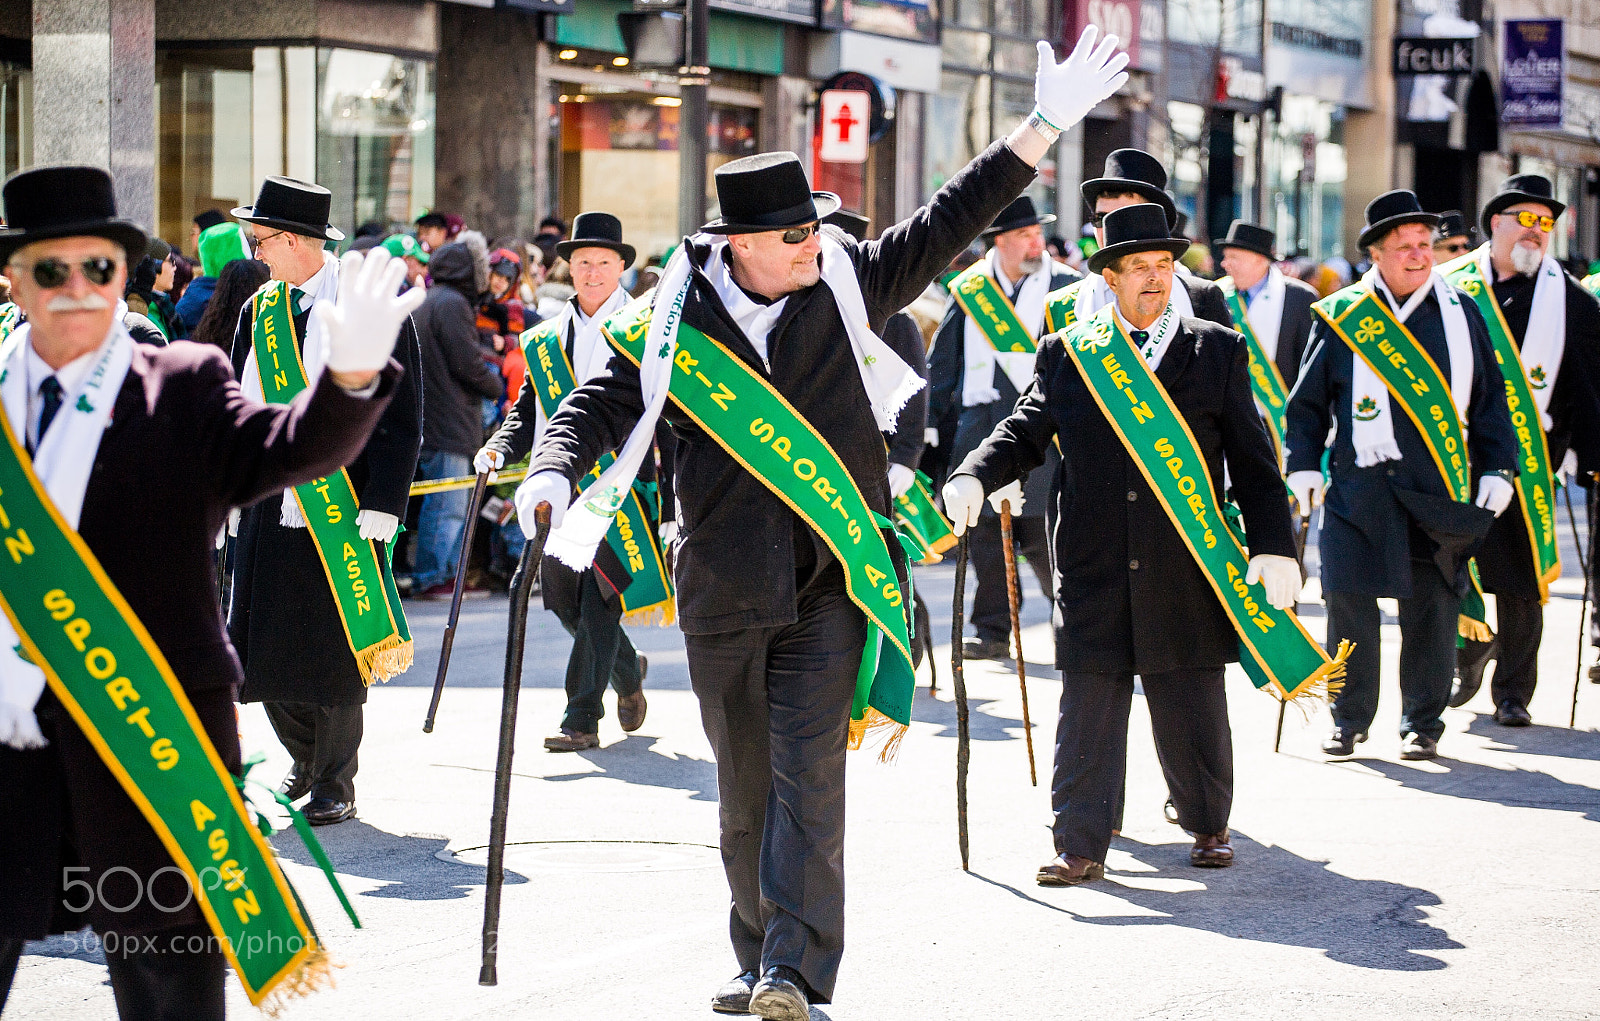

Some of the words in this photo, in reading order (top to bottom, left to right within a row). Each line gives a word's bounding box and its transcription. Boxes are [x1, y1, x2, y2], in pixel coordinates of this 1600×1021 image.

[1398, 40, 1471, 71] fcuk
[974, 291, 1011, 336] ERIN
[1152, 318, 1170, 345] Erin
[263, 314, 288, 391] ERIN
[536, 341, 562, 400] ERIN
[671, 340, 737, 412] RIN
[749, 417, 862, 545] SPORTS
[1377, 338, 1430, 397] ERIN
[1429, 404, 1469, 504] SPORTS
[1101, 352, 1155, 425] ERIN
[1153, 437, 1218, 549] SPORTS
[1225, 561, 1276, 634] ASSN
[1533, 484, 1553, 547] ASSN
[616, 509, 645, 573] ASSN
[343, 541, 371, 616] ASSN
[42, 588, 180, 771] SPORTS
[189, 799, 261, 924] ASSN
